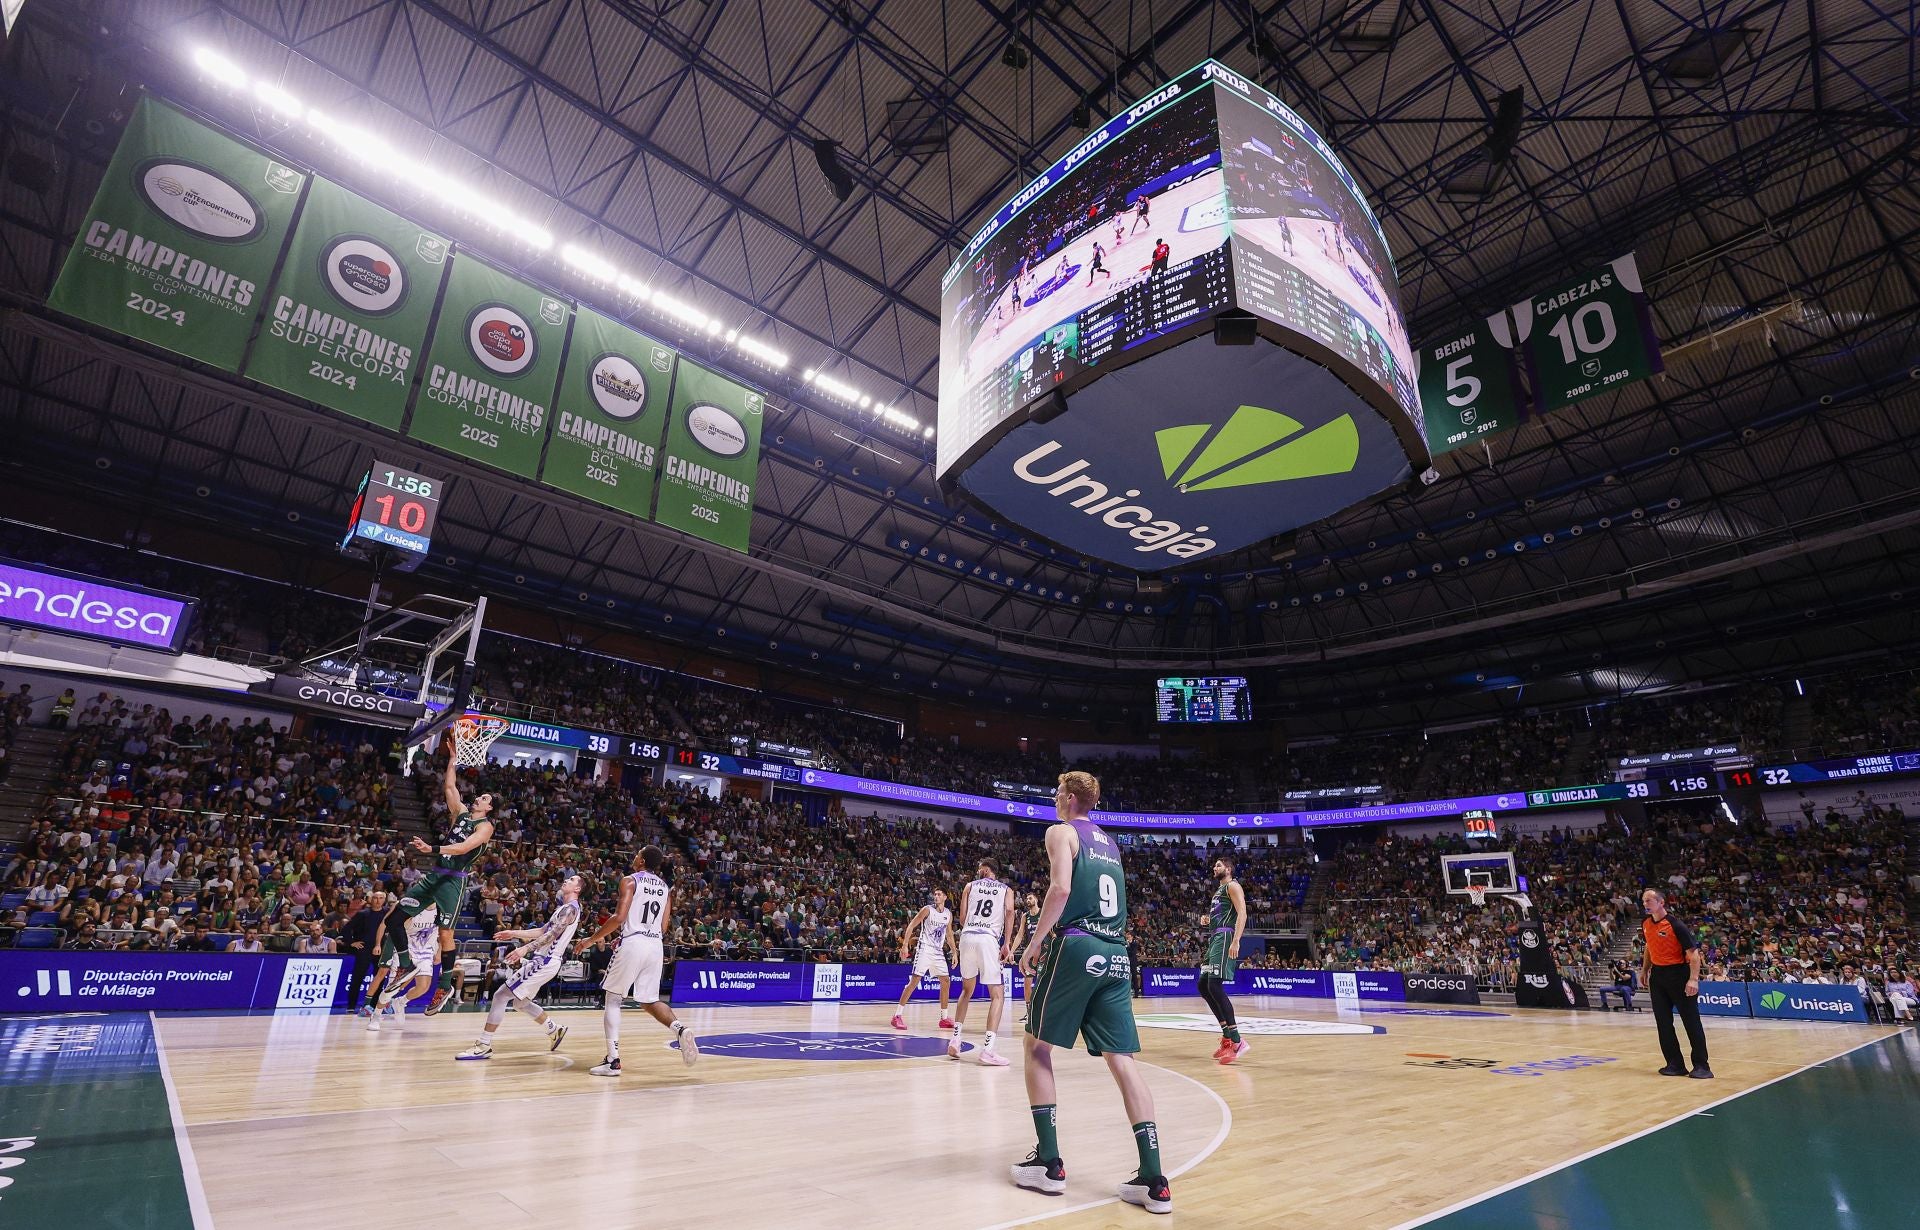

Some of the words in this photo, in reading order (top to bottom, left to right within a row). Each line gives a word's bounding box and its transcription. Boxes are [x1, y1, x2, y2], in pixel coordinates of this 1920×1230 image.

[1202, 63, 1250, 95] Joma
[1126, 82, 1181, 124] Joma
[1266, 97, 1305, 134] Joma
[1064, 129, 1110, 171] Joma
[1316, 138, 1345, 177] Joma
[183, 197, 198, 206] CUP
[1010, 176, 1049, 214] Joma
[185, 191, 252, 226] INTERCONTINENTAL
[969, 218, 999, 256] Joma
[85, 220, 256, 307] CAMPEONES
[344, 260, 388, 284] supercopa
[1163, 260, 1194, 277] PETRASEK
[82, 245, 116, 265] FIBA
[126, 260, 247, 316] INTERCONTINENTAL
[346, 268, 387, 290] endesa
[1164, 270, 1191, 286] PANTZAR
[152, 283, 177, 297] CUP
[1164, 284, 1184, 296] SYLLA
[1536, 273, 1612, 316] CABEZAS
[1165, 294, 1181, 305] FONT
[1166, 298, 1196, 315] HLINASON
[126, 292, 186, 327] 2024
[1166, 307, 1200, 325] LAZAREVIC
[1087, 313, 1100, 325] FREY
[272, 295, 412, 371] CAMPEONES
[488, 331, 511, 345] Copa
[1549, 301, 1617, 364] 10
[270, 320, 407, 386] SUPERCOPA
[497, 342, 512, 353] Rey
[1052, 349, 1065, 363] 32
[1091, 344, 1112, 359] ZECEVIC
[1435, 333, 1476, 361] BERNI
[308, 360, 357, 391] 2024
[1022, 369, 1034, 384] 39
[1034, 369, 1052, 383] FALTAS
[1054, 371, 1064, 382] 11
[1446, 354, 1482, 407] 5
[1566, 384, 1591, 399] 2000
[1603, 369, 1629, 385] 2009
[429, 364, 544, 428] CAMPEONES
[598, 378, 621, 393] FINAL
[620, 385, 641, 400] FOUR
[1022, 384, 1042, 402] 1:56
[427, 388, 468, 412] COPA
[474, 403, 504, 425] DEL
[510, 417, 540, 438] REY
[460, 423, 499, 448] 2025
[559, 410, 655, 467] CAMPEONES
[1447, 430, 1467, 444] 1999
[1477, 420, 1497, 434] 2012
[591, 450, 618, 470] BCL
[384, 471, 432, 497] 1:56
[585, 465, 618, 487] 2025
[666, 455, 750, 504] CAMPEONES
[666, 476, 683, 485] FIBA
[687, 481, 748, 509] INTERCONTINENTAL
[701, 494, 714, 503] CUP
[1013, 440, 1217, 559] Unicaja
[376, 494, 427, 534] 10
[691, 503, 719, 524] 2025
[384, 532, 424, 550] Unicaja
[299, 683, 393, 713] endesa
[510, 722, 560, 742] UNICAJA
[588, 735, 609, 753] 39
[629, 742, 659, 759] 1:56
[679, 750, 694, 765] 11
[701, 755, 719, 771] 32
[1856, 756, 1892, 767] SURNE
[743, 767, 761, 777] BILBAO
[761, 770, 781, 779] BASKET
[762, 763, 782, 772] SURNE
[1828, 769, 1858, 778] BILBAO
[1860, 765, 1894, 775] BASKET
[1669, 777, 1708, 792] 1:56
[1732, 772, 1752, 786] 11
[1763, 769, 1792, 785] 32
[857, 781, 880, 792] PUEDES
[880, 784, 892, 794] VER
[892, 787, 899, 795] EL
[900, 788, 922, 798] PARTIDO
[937, 793, 957, 802] MARTÍN
[1552, 789, 1599, 802] UNICAJA
[1626, 783, 1649, 798] 39
[1089, 813, 1100, 821] VER
[1107, 814, 1130, 823] PARTIDO
[1147, 815, 1168, 824] MARTÍN
[1168, 817, 1195, 825] CARPENA
[1306, 812, 1331, 821] PUEDES
[1331, 811, 1344, 820] VER
[1344, 810, 1353, 819] EL
[1353, 808, 1380, 818] PARTIDO
[1380, 807, 1390, 816] EN
[1391, 807, 1399, 815] EL
[1399, 803, 1425, 814] MARTÍN
[1425, 802, 1457, 812] CARPENA
[1465, 810, 1483, 818] 1:56
[1467, 820, 1485, 832] 10
[1099, 873, 1118, 918] 9
[640, 900, 661, 925] 19
[974, 899, 993, 917] 18
[292, 962, 321, 971] sabor
[721, 971, 758, 980] Diputación
[758, 971, 790, 980] Provincial
[820, 969, 838, 982] má
[83, 970, 163, 983] Diputación
[166, 970, 232, 982] Provincial
[297, 968, 331, 985] má
[719, 981, 729, 989] de
[730, 980, 755, 989] Málaga
[1408, 977, 1466, 991] endesa
[1524, 974, 1550, 989] Risi
[78, 984, 98, 996] de
[102, 983, 156, 998] Málaga
[285, 983, 328, 1005] laga
[816, 982, 838, 996] laga
[1336, 985, 1355, 996] laga
[1698, 994, 1740, 1007] nicaja
[1790, 997, 1854, 1014] Unicaja
